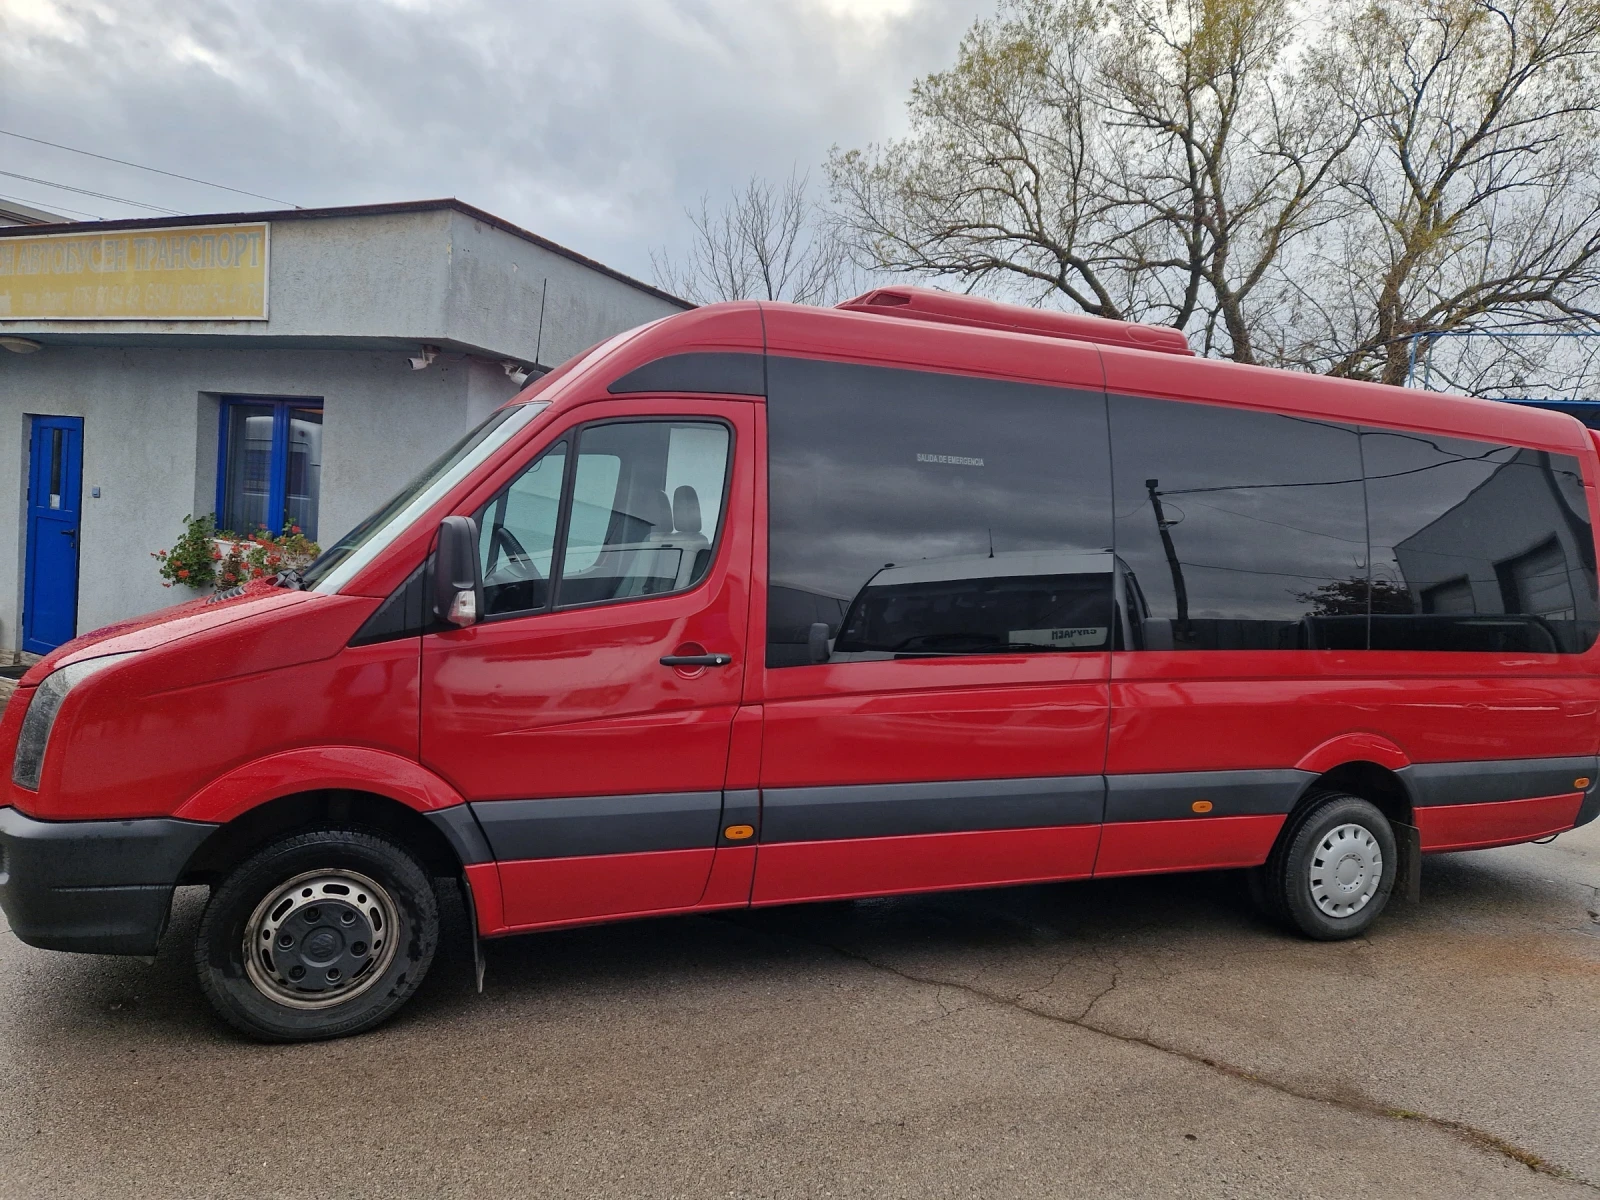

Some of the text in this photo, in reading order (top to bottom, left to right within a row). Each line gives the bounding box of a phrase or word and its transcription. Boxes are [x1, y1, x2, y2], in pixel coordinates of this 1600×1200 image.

[18, 239, 128, 275] АВТОБУСЕН
[133, 231, 261, 271] ТРАНСПОРТ
[916, 453, 984, 466] SALIDA DE EMERGENCIA
